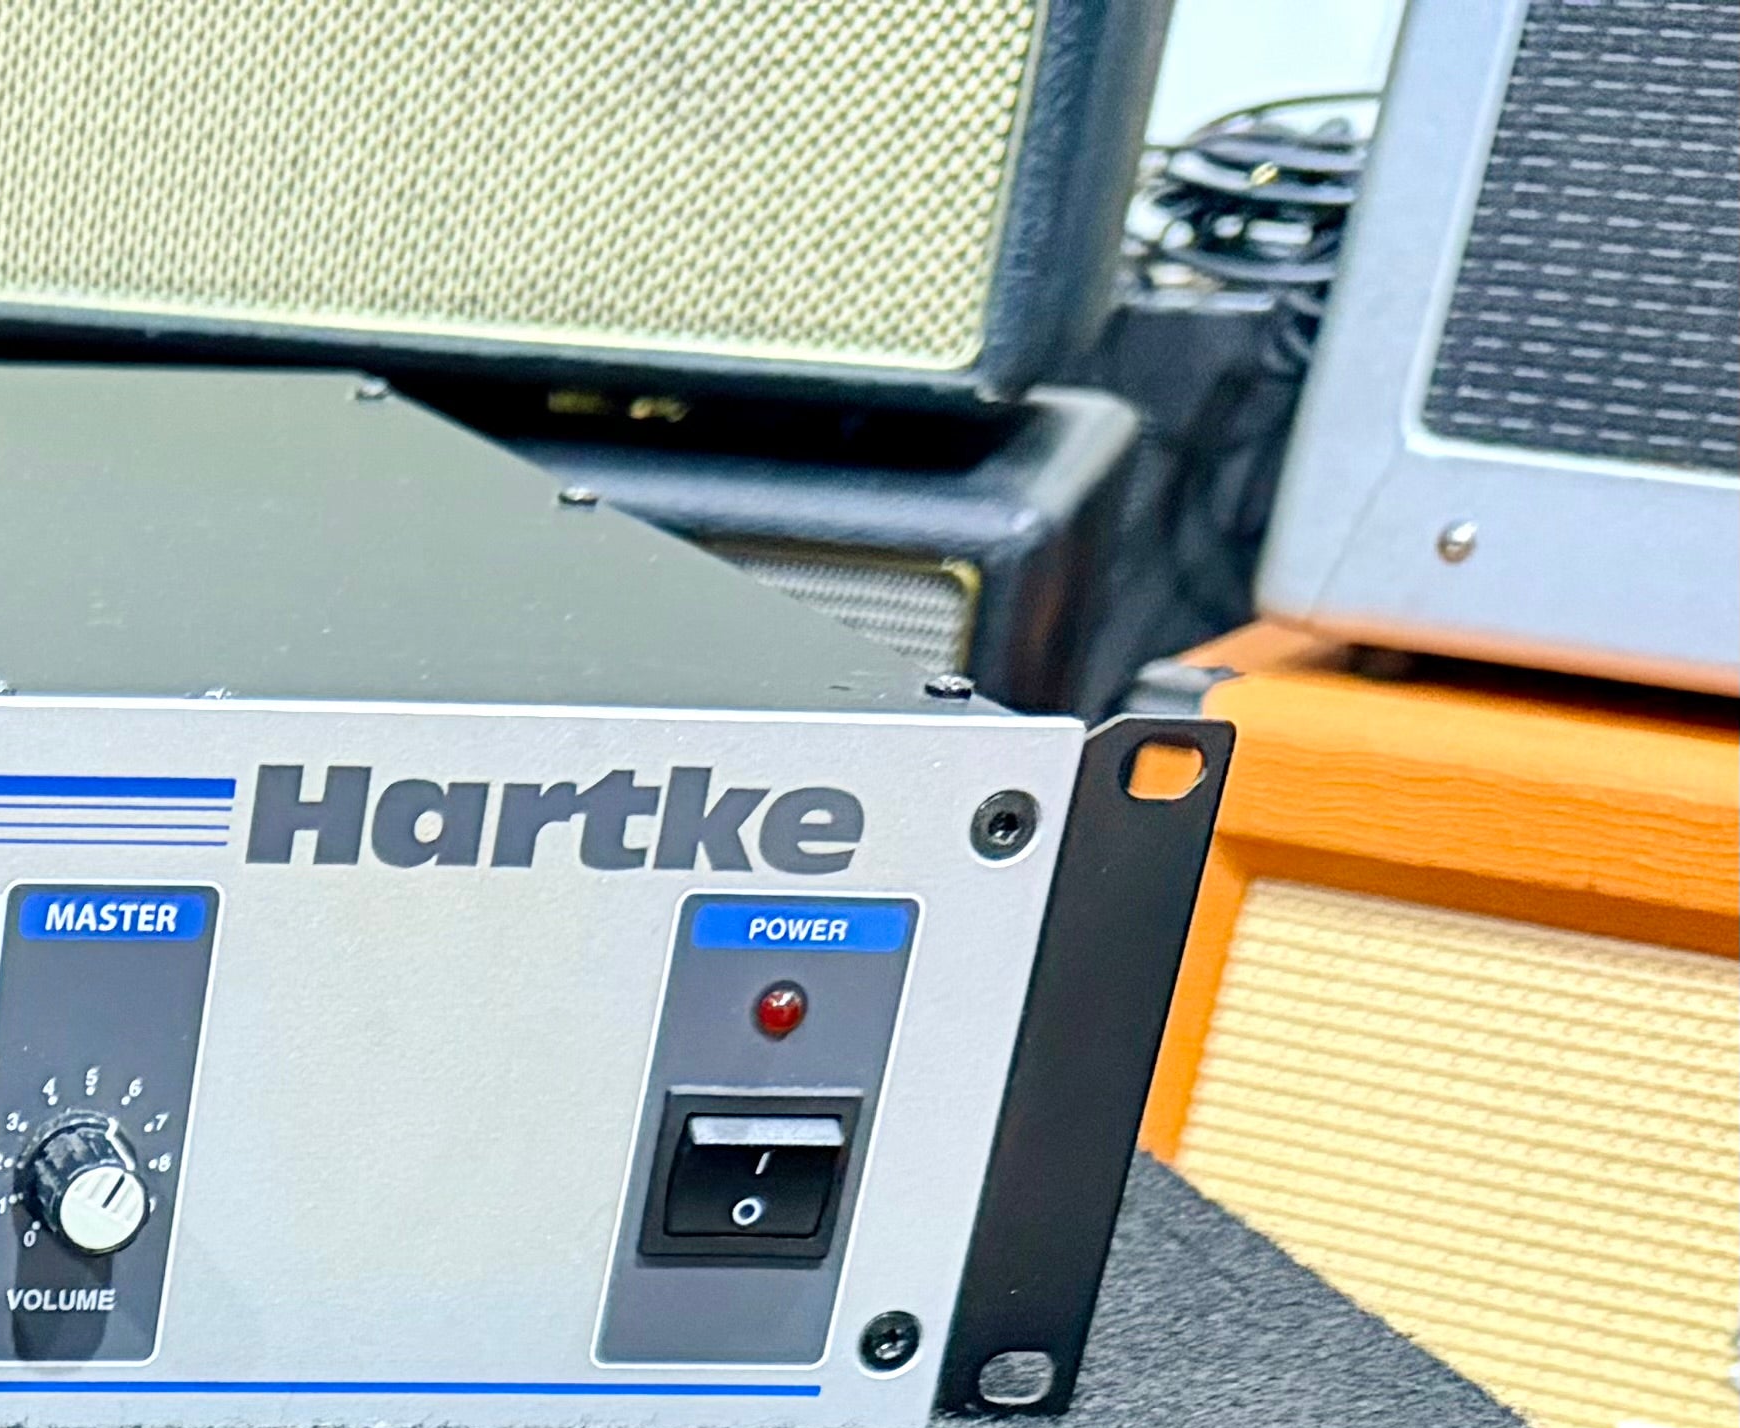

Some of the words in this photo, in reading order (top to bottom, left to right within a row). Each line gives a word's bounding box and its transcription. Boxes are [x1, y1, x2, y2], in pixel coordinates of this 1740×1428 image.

[245, 764, 865, 874] Hartke
[44, 902, 178, 933] MASTER
[748, 917, 848, 942] POWER
[85, 1066, 101, 1085] 5
[43, 1078, 57, 1095] 4
[129, 1078, 143, 1096] 6
[6, 1113, 20, 1130] 3
[154, 1112, 170, 1130] 7
[158, 1154, 172, 1172] 8
[23, 1230, 36, 1247] 0
[6, 1289, 116, 1311] VOLUME
